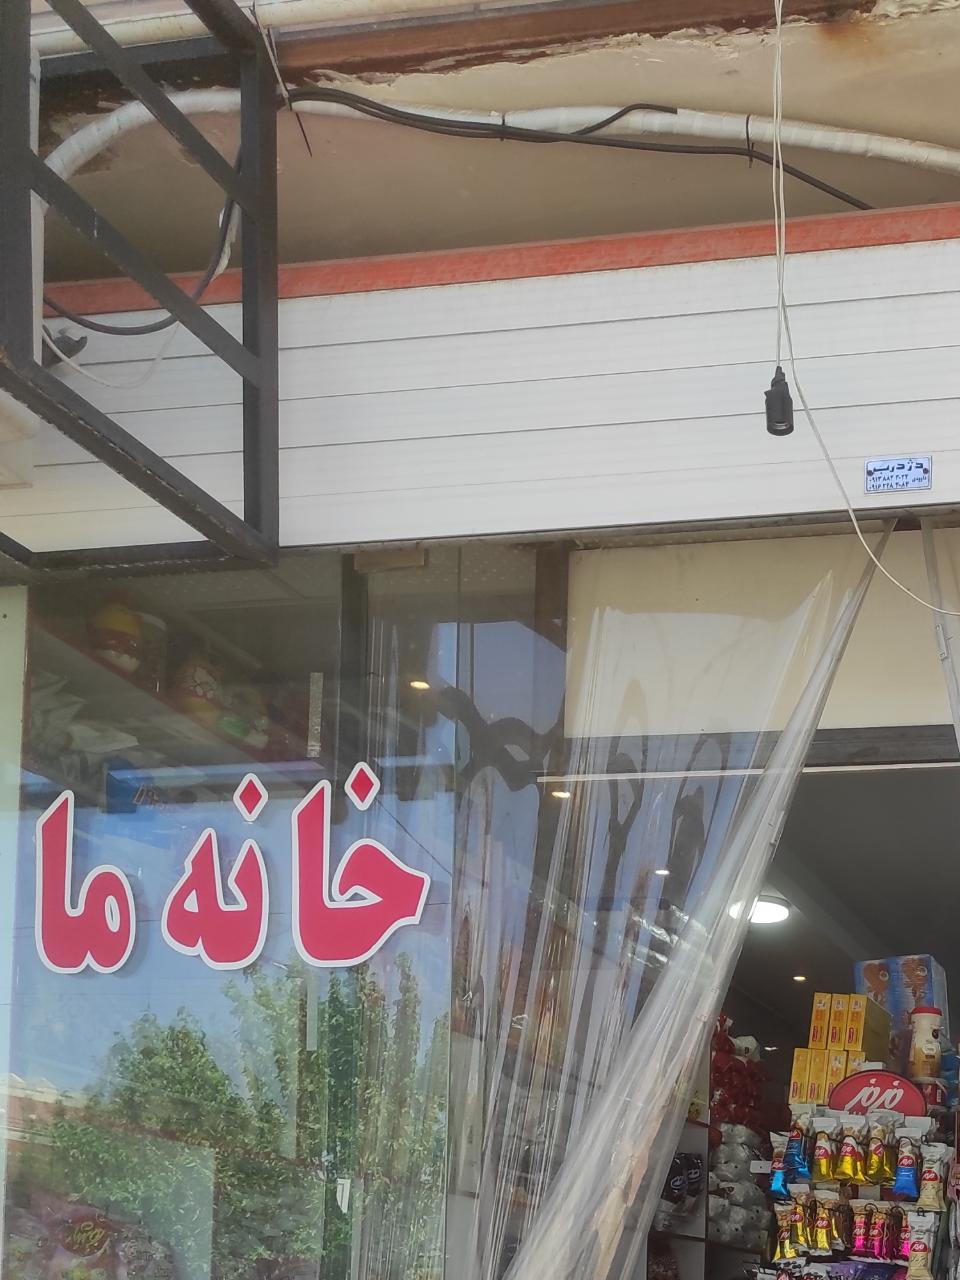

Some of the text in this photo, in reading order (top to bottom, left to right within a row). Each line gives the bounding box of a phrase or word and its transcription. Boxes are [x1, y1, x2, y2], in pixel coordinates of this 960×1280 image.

[36, 761, 431, 974] خانه ما
[844, 1078, 904, 1115] مزمز
